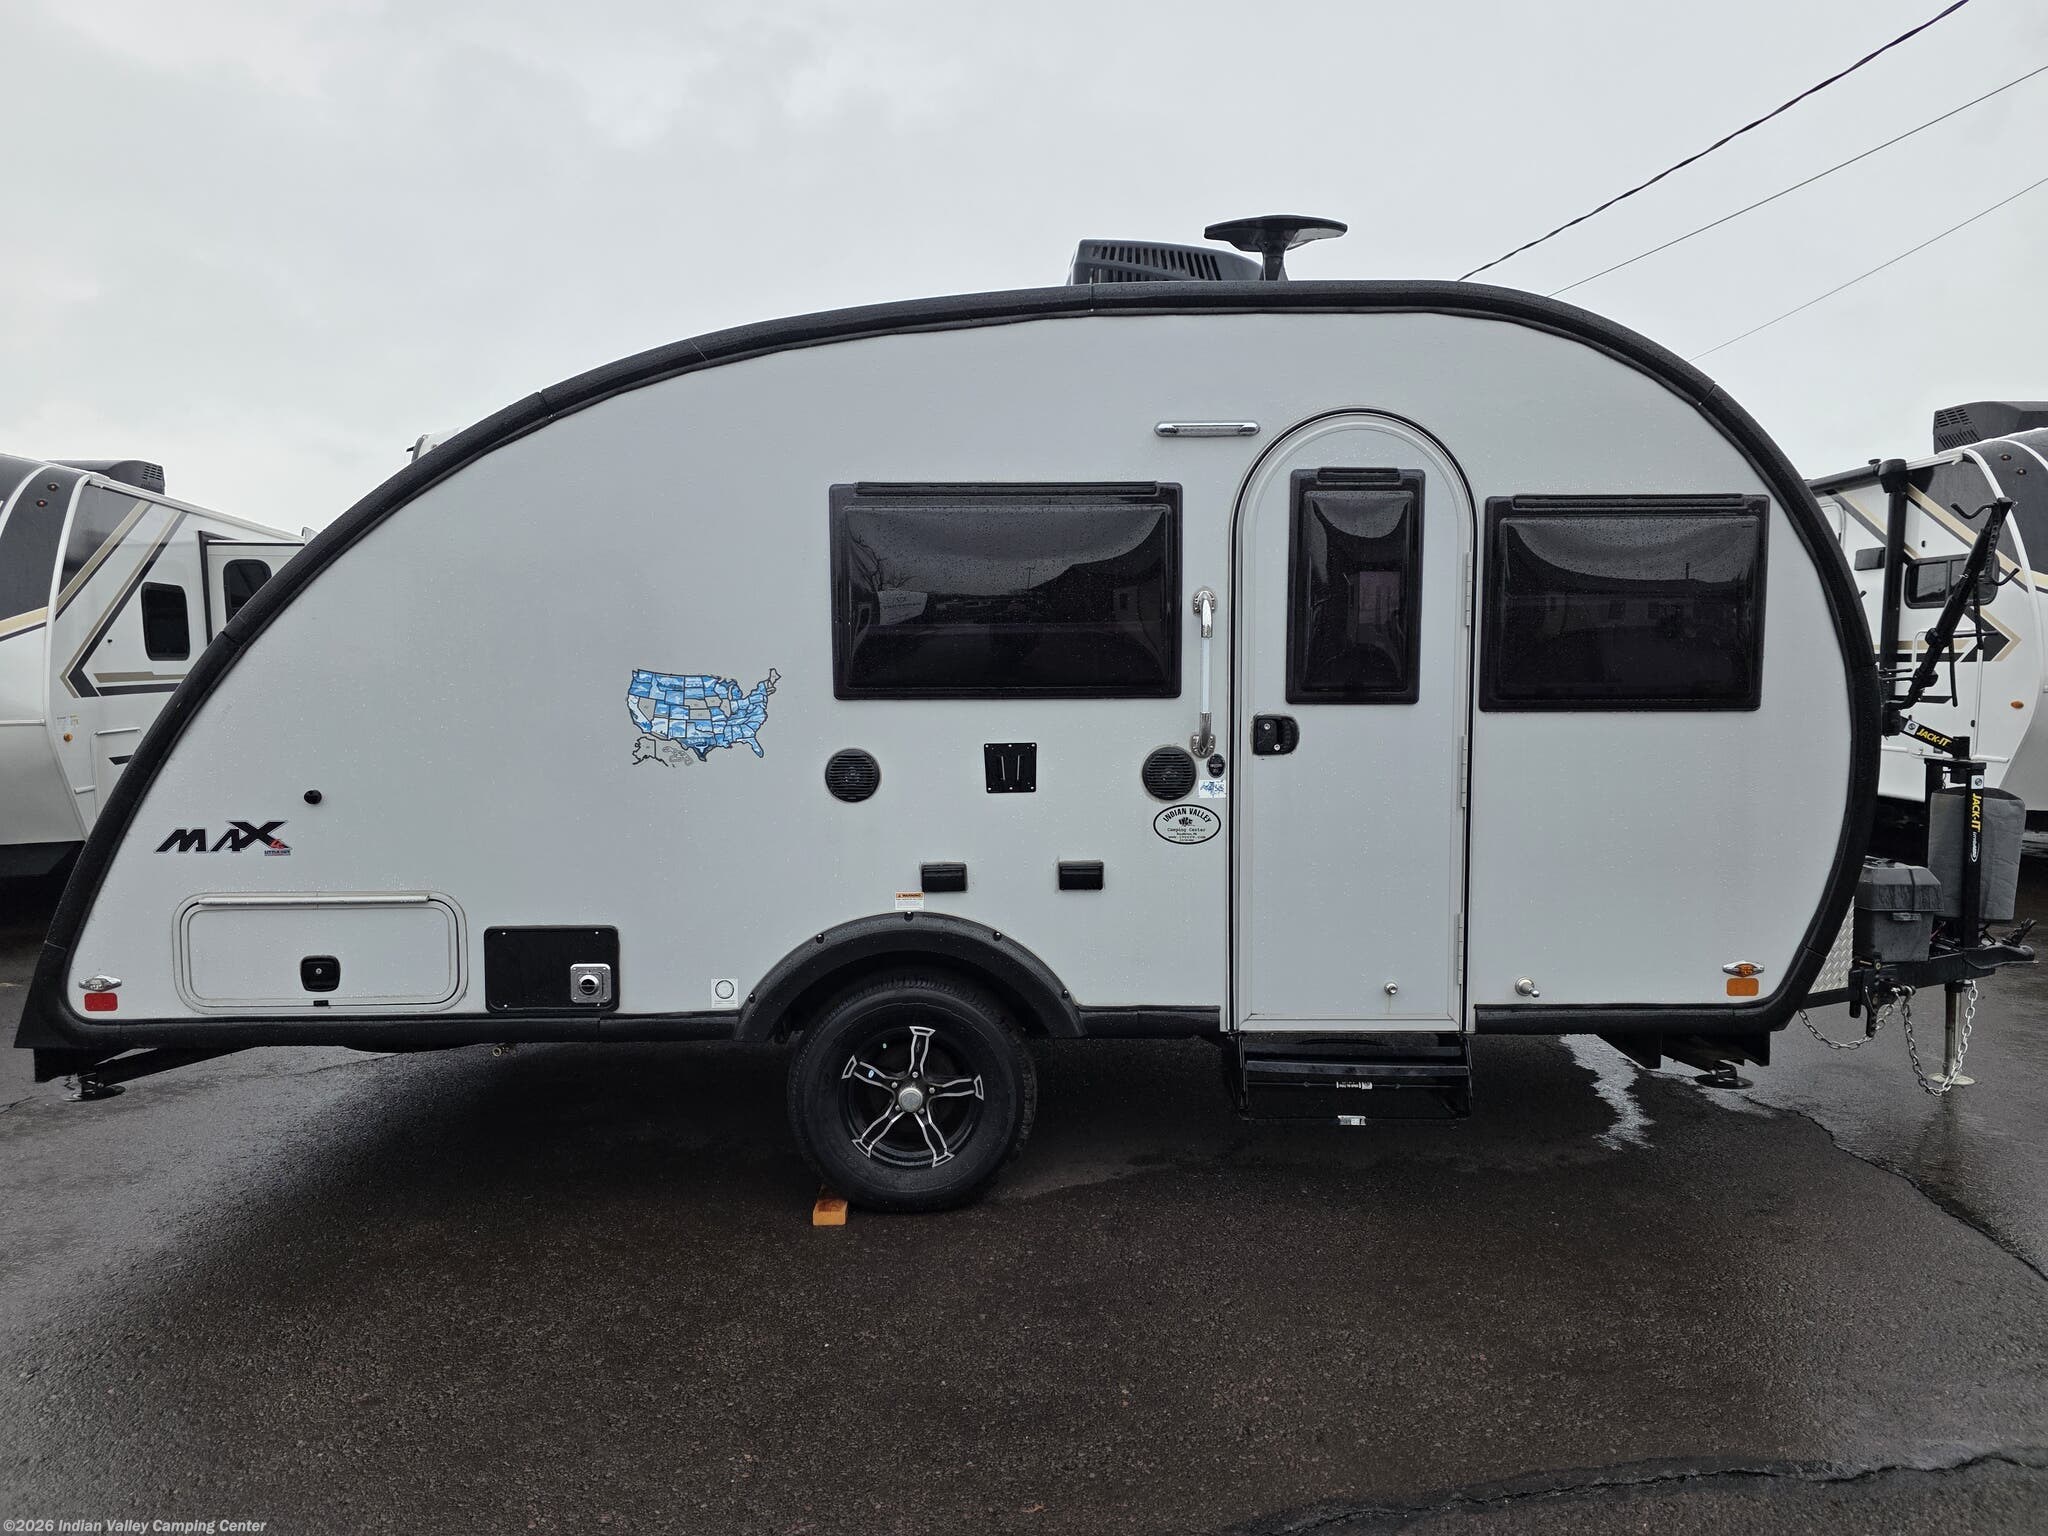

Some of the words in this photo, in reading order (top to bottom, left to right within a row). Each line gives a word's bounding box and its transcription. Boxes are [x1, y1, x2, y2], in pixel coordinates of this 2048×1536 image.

[1163, 808, 1187, 823] INDIAN
[1189, 808, 1212, 823] VALLEY
[155, 821, 290, 852] MAX
